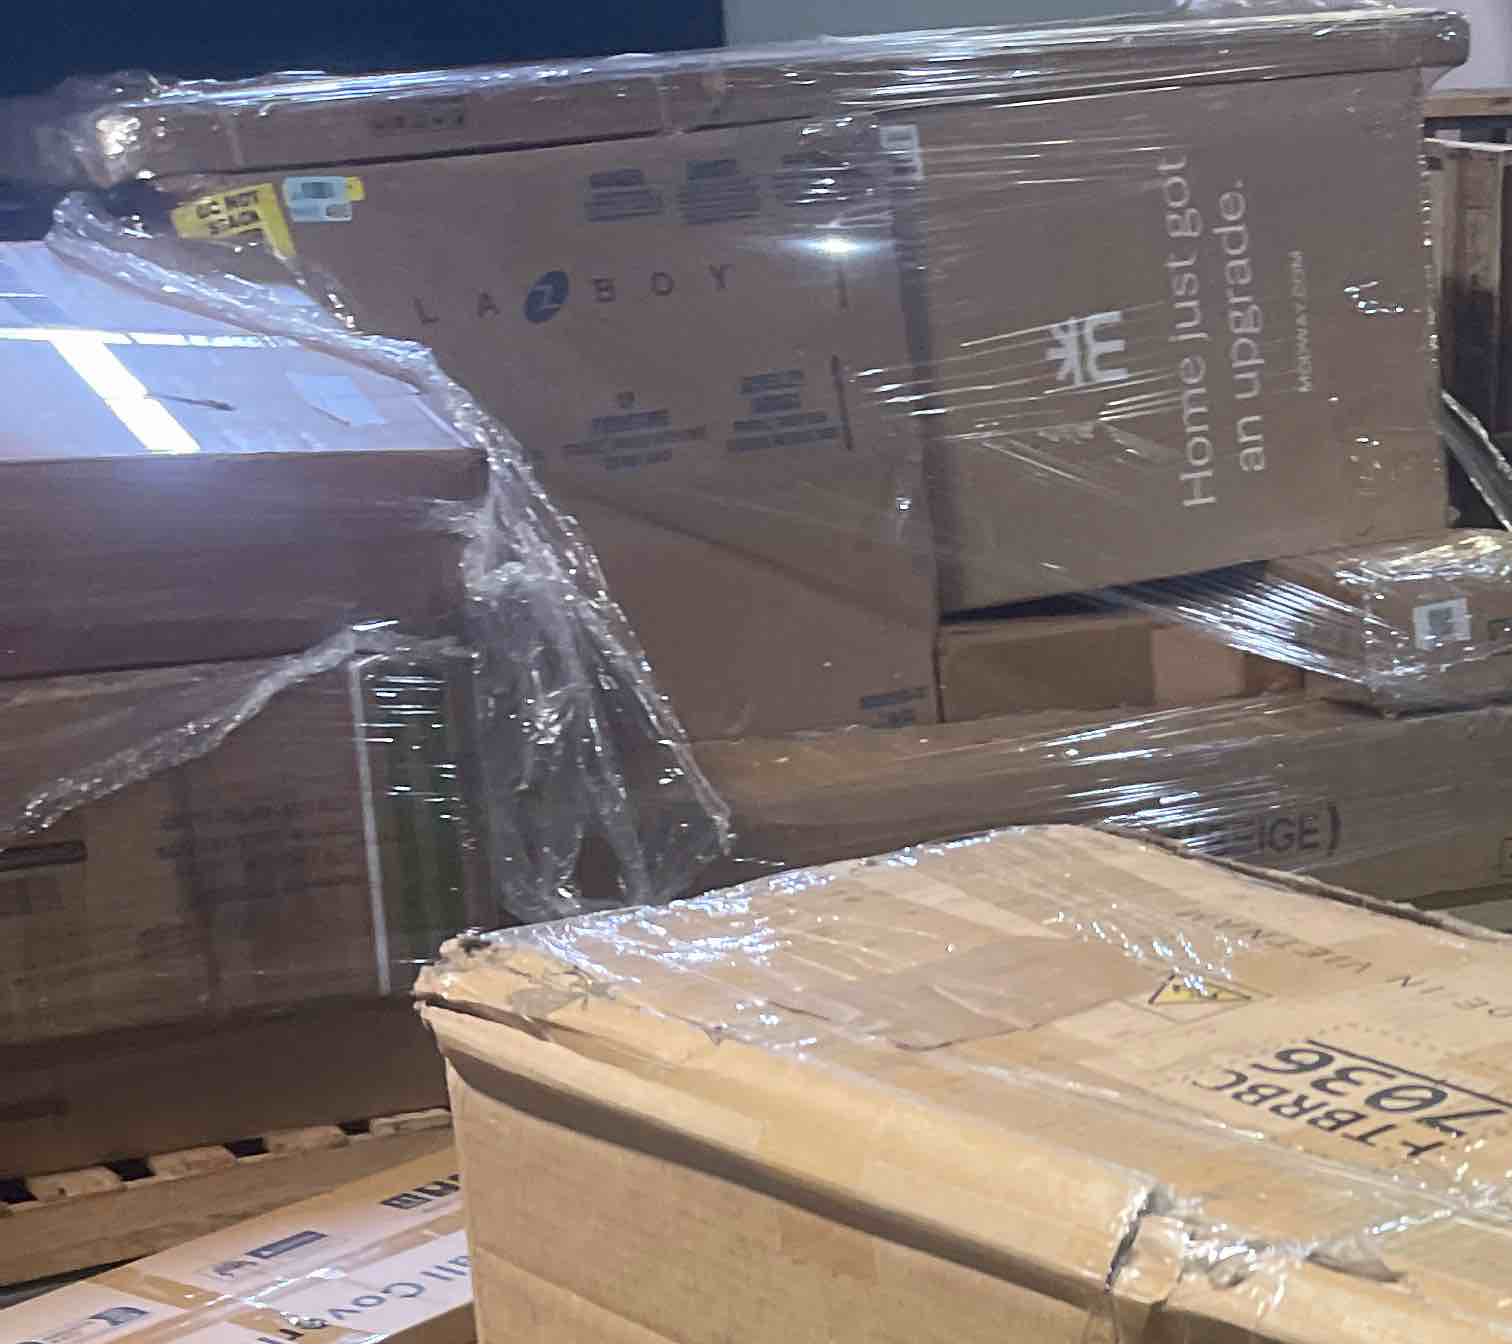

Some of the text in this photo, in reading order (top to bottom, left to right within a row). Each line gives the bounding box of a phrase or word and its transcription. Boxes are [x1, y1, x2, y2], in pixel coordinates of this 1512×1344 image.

[1157, 155, 1217, 507] Home just got
[1213, 178, 1264, 472] an upgrade.
[1254, 1046, 1504, 1138] 7036
